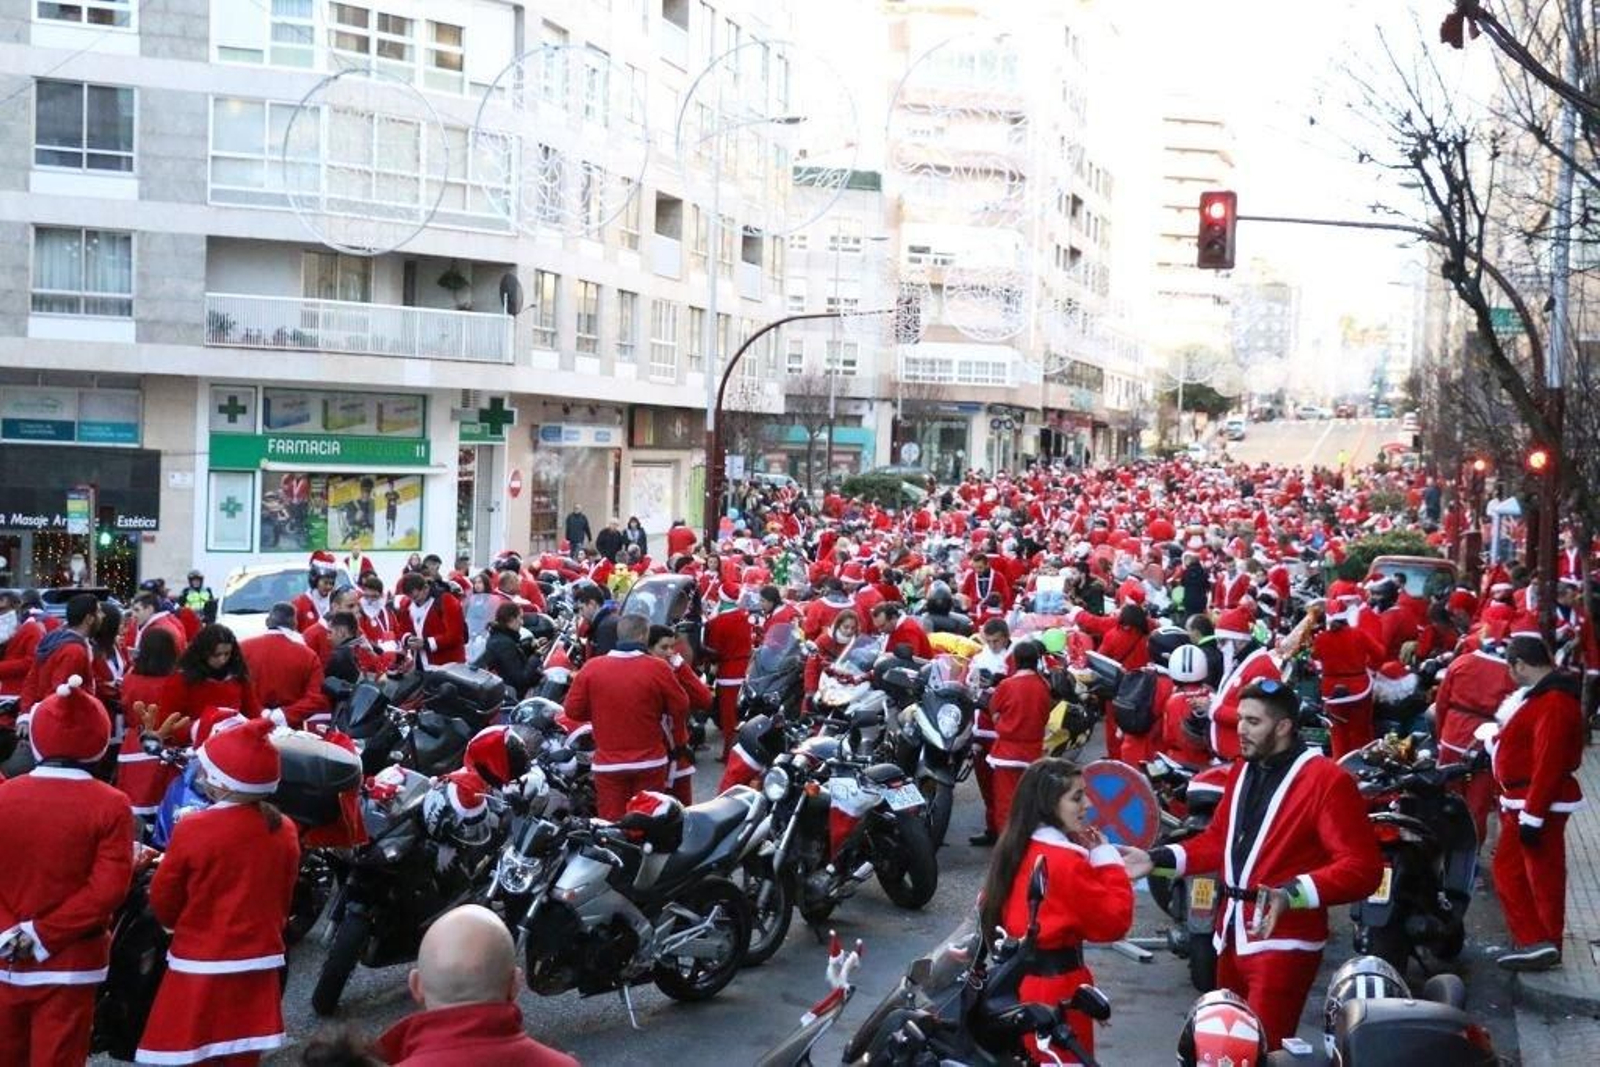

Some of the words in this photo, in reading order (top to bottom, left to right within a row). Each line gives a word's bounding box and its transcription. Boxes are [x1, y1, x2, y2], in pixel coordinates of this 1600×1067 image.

[268, 438, 341, 455] FARMACIA
[10, 513, 49, 529] Masaje
[116, 514, 157, 528] Estética
